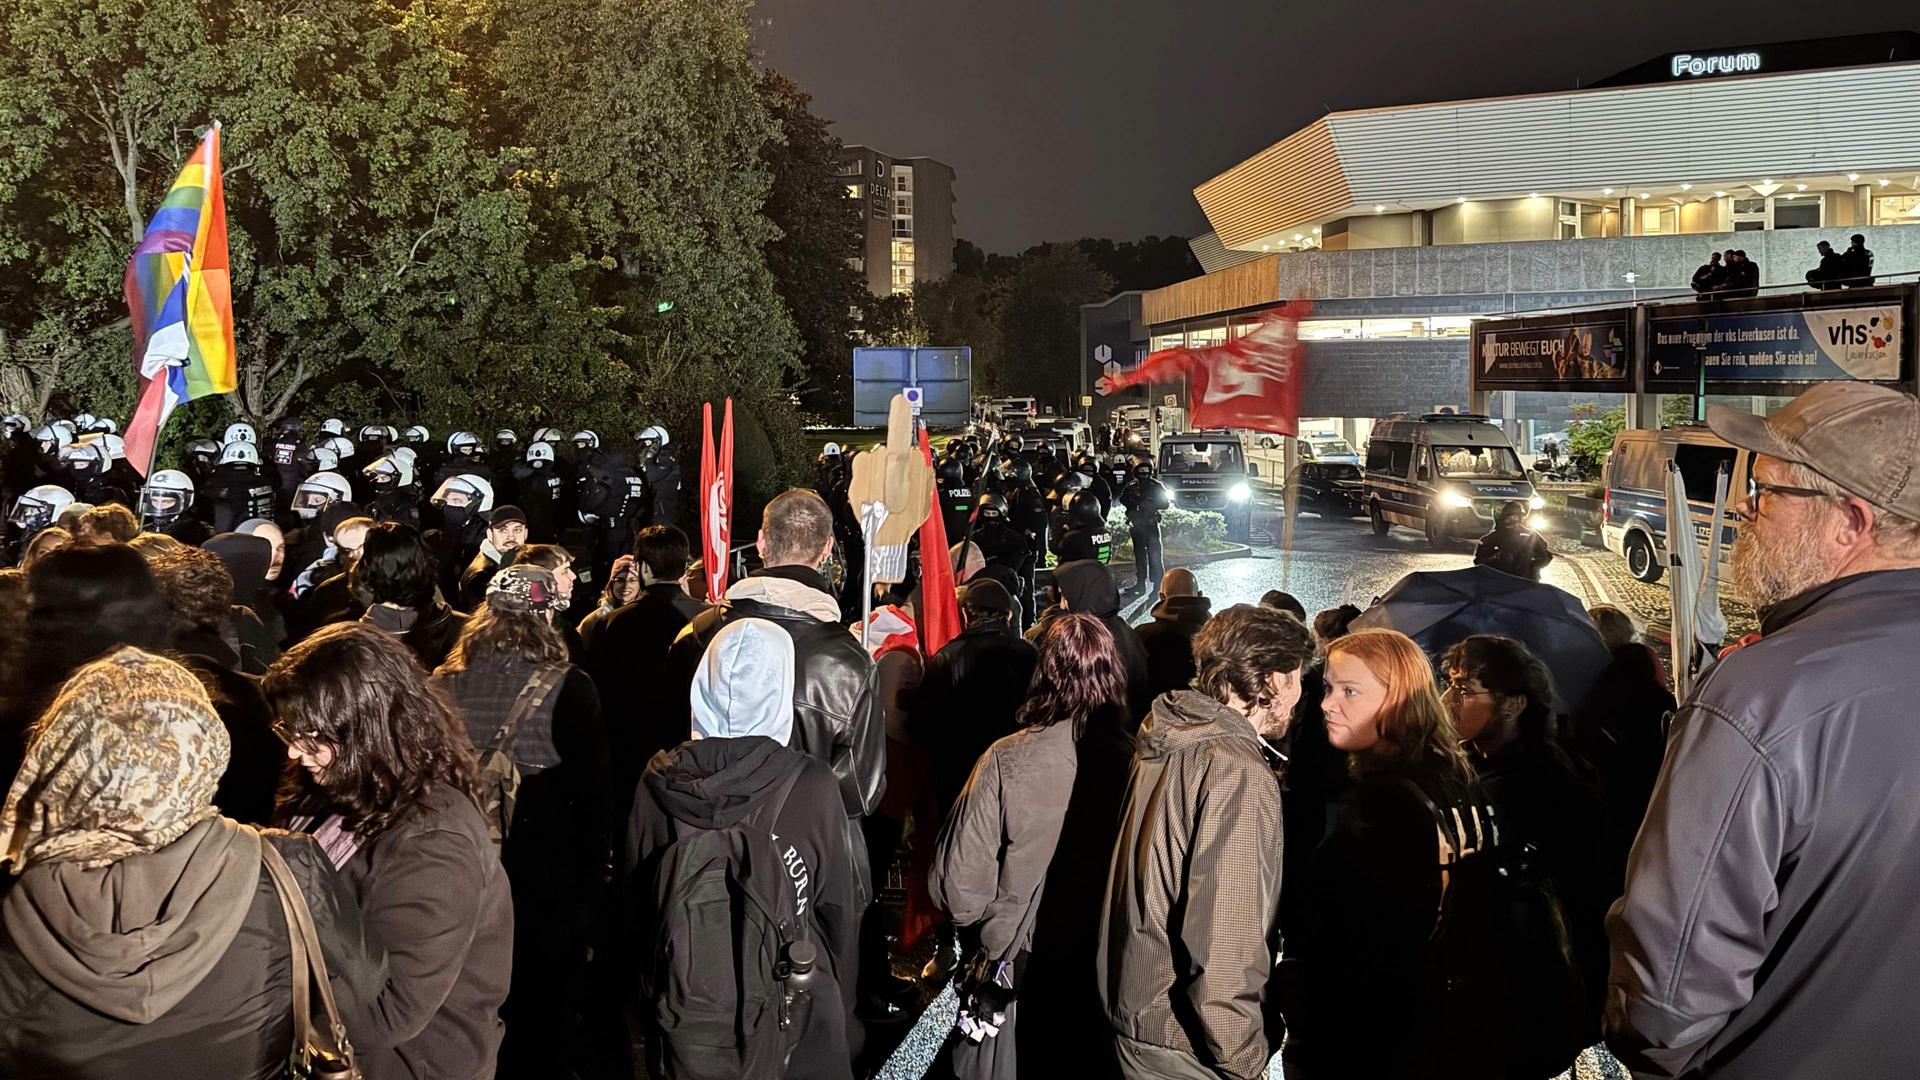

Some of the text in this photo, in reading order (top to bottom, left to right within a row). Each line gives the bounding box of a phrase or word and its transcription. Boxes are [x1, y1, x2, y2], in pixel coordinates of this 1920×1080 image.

[1672, 53, 1760, 76] Forum
[870, 182, 891, 199] DELTA
[1657, 331, 1668, 345] Das
[1668, 334, 1682, 345] neue
[1713, 329, 1724, 342] der
[1725, 328, 1737, 342] vhs
[1737, 326, 1776, 341] Leverkusen
[1777, 325, 1787, 341] ist
[1788, 325, 1800, 340] da.
[1828, 318, 1868, 346] vhs
[1482, 338, 1565, 357] KULTUR BEWEGT EUCH
[1721, 352, 1731, 366] Sie
[1732, 352, 1748, 368] rein,
[1749, 351, 1774, 366] melden
[1775, 350, 1786, 366] Sie
[1788, 350, 1804, 365] sich
[1805, 349, 1818, 365] an!
[226, 450, 237, 458] 14
[948, 488, 972, 498] POLIZE
[1477, 486, 1520, 494] POLIZEI
[1091, 532, 1112, 545] POLIZE
